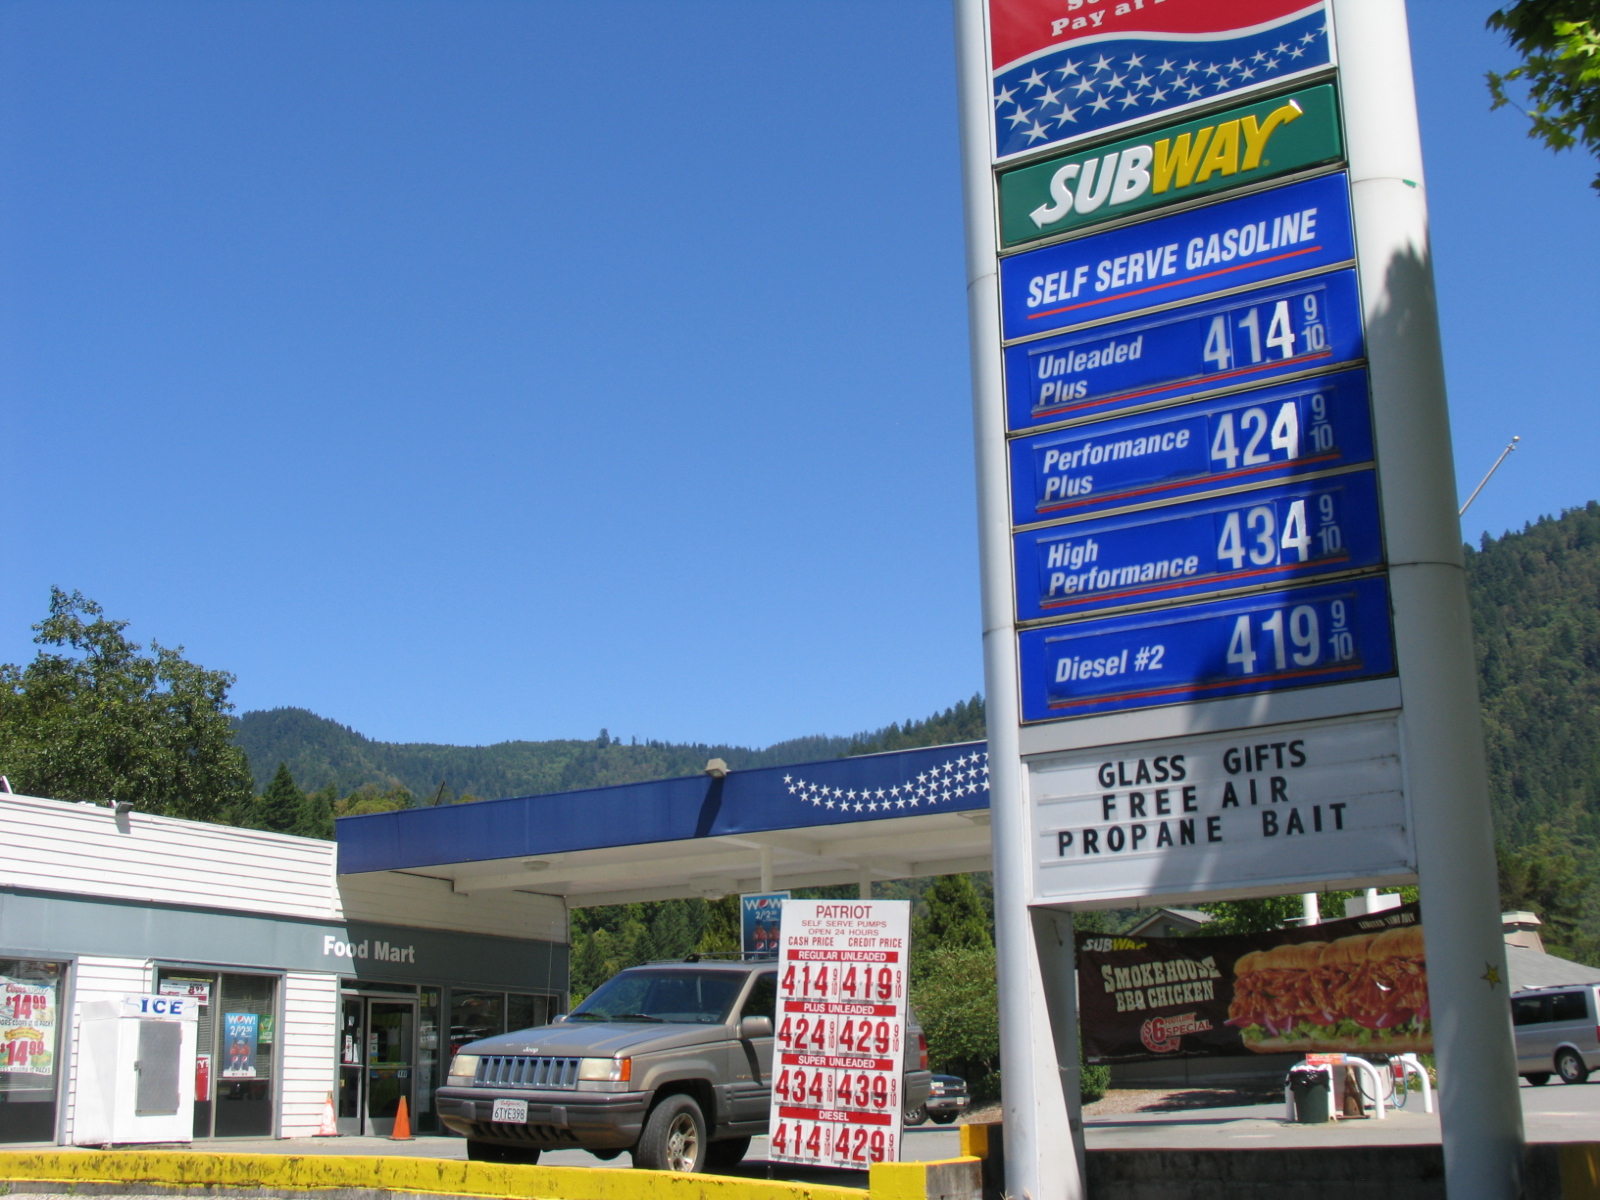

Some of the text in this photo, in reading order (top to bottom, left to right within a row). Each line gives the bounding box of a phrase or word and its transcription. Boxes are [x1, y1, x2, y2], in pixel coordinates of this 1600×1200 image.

[1050, 9, 1106, 37] Pay
[1029, 100, 1303, 229] SUBWAY
[1027, 208, 1318, 309] SELF SERVE GASOLINE
[1202, 300, 1296, 371] 414
[1037, 335, 1143, 380] Unleaded
[1039, 379, 1088, 406] Plus
[1043, 428, 1191, 474] Performance
[1210, 401, 1299, 470] 424
[1044, 474, 1093, 501] Plus
[1216, 500, 1312, 569] 434
[1047, 538, 1099, 571] High
[1048, 553, 1199, 597] Performance
[1226, 604, 1321, 674] 419
[1055, 644, 1166, 684] Diesel #2
[1098, 739, 1307, 789] GLASS GIFTS
[1102, 776, 1289, 821] FREE AIR
[1058, 802, 1347, 857] PROPANE BAIT
[816, 905, 873, 919] PATRIOT
[323, 935, 415, 963] Food Mart
[788, 936, 834, 947] CASH PRICE
[798, 951, 887, 961] REGULAR UNLEADED
[848, 938, 902, 948] CREDIT PRICE
[781, 965, 829, 997] 414
[842, 966, 893, 1000] 419
[1101, 956, 1222, 993] SMOKEHOUSE
[140, 997, 184, 1015] ICE
[804, 1003, 875, 1014] PLUS UNLEADED
[1115, 980, 1215, 1012] BBQ CHICKEN
[779, 1017, 825, 1050] 424
[840, 1020, 890, 1054] 429
[1144, 1018, 1167, 1042] $6
[1166, 1020, 1213, 1038] SPECIAL
[798, 1055, 876, 1068] SUPER UNLEADED
[775, 1069, 823, 1103] 434
[837, 1074, 887, 1109] 439
[818, 1110, 849, 1121] DIESEL
[772, 1123, 821, 1157] 414
[835, 1128, 885, 1162] 429
